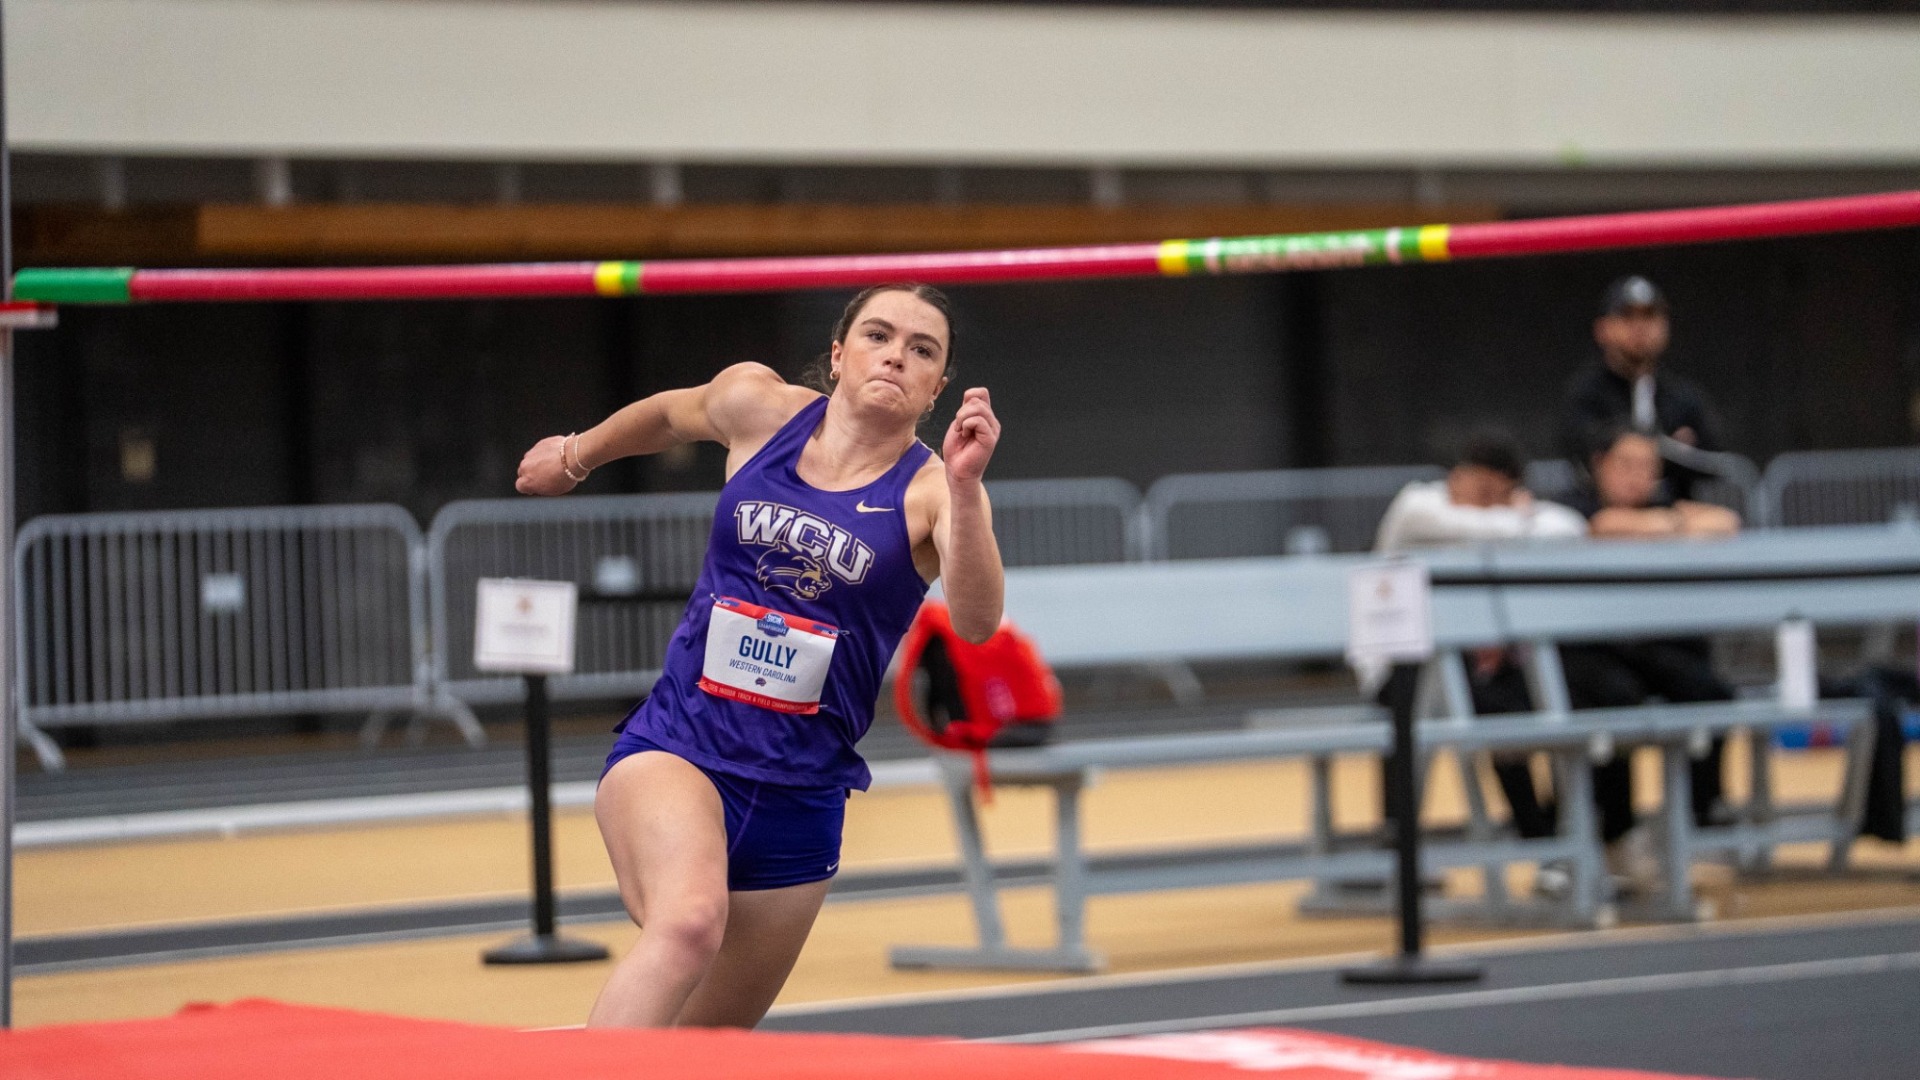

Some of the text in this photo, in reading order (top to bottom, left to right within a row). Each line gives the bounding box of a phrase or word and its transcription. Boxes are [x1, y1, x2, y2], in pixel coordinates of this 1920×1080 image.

[734, 501, 875, 585] WCU
[739, 635, 798, 669] GULLY
[729, 658, 797, 683] WESTERN CAROLINA
